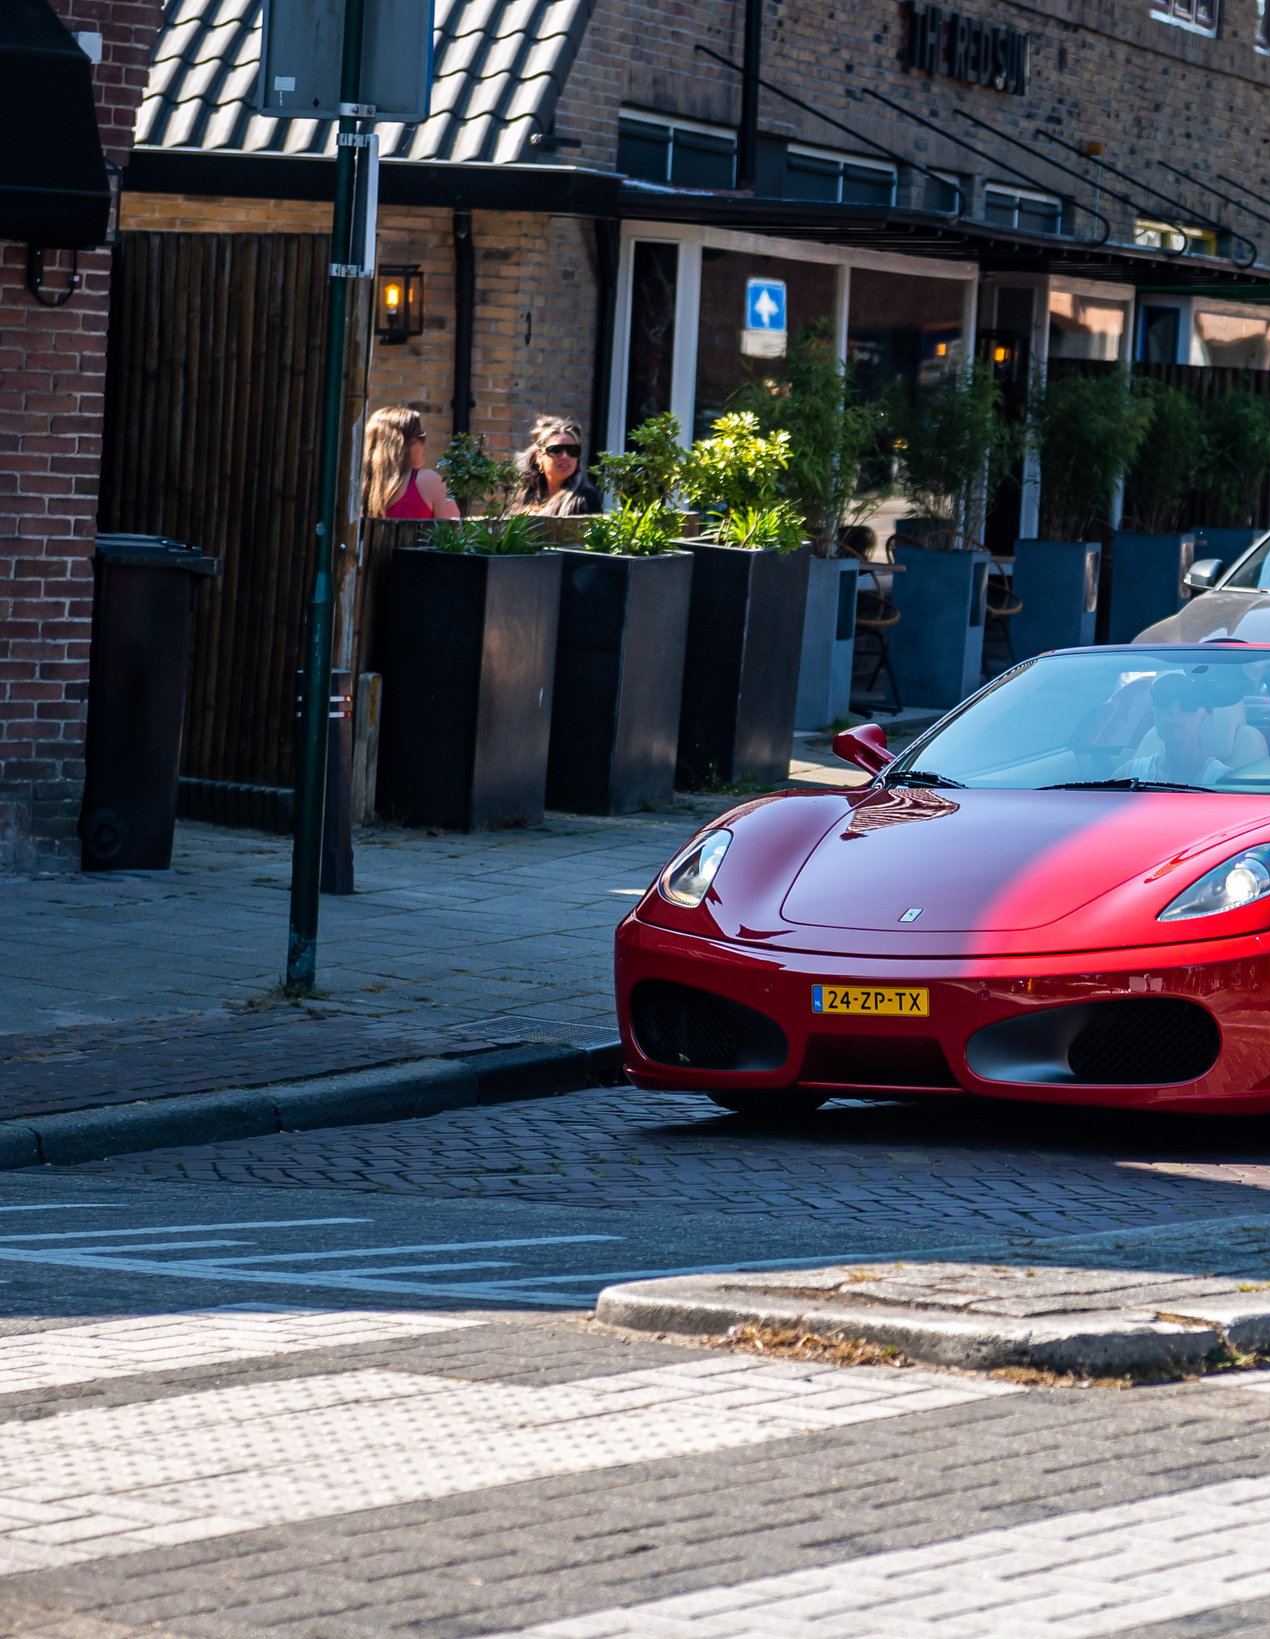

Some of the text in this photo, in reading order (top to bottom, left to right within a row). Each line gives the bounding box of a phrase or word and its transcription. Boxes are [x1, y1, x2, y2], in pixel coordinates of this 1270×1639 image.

[904, 2, 1030, 96] THE RED SUN
[828, 990, 921, 1011] 24-ZP-TX
